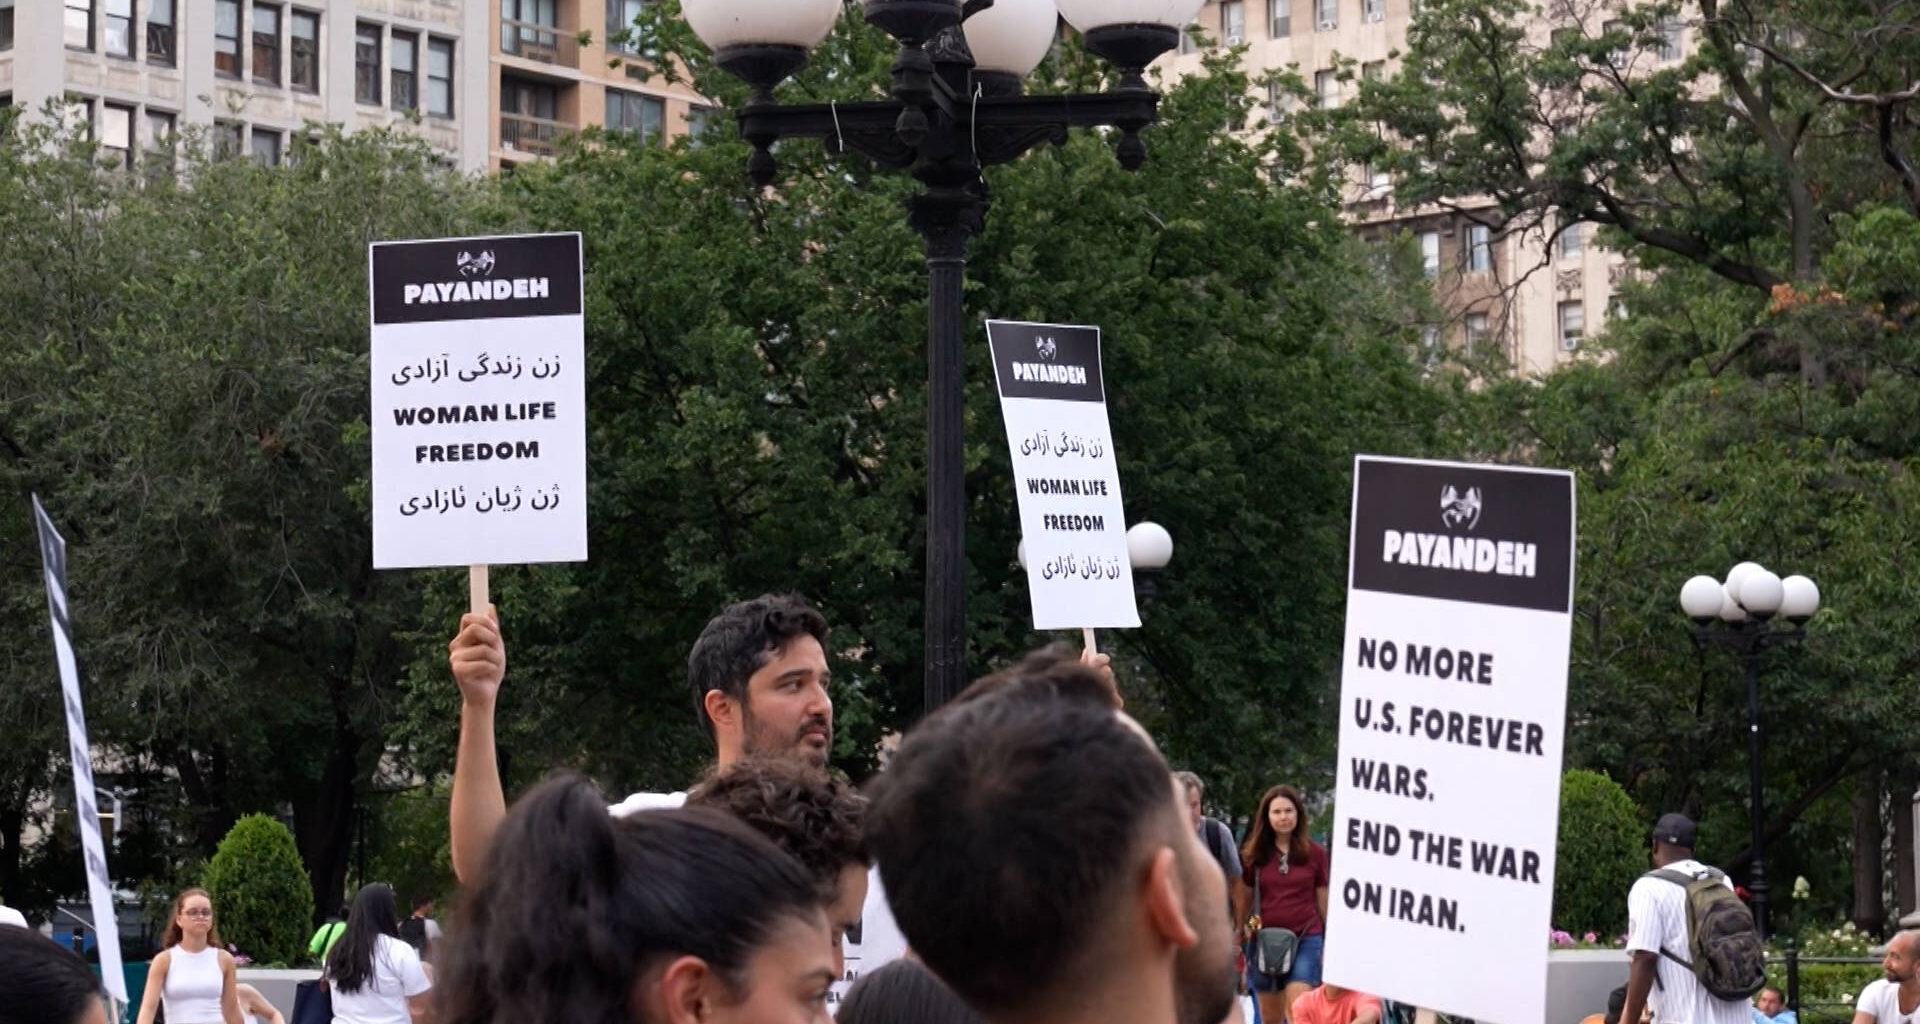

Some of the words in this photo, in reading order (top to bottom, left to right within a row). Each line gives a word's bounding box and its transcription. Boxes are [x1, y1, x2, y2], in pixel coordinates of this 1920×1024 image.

[404, 277, 548, 304] PAYANDEH
[391, 353, 449, 386] آزادی
[457, 352, 522, 383] زندگی
[531, 355, 561, 379] زن
[1012, 362, 1087, 385] PAYANDEH
[393, 404, 499, 426] WOMAN
[505, 401, 557, 421] LIFE
[415, 440, 540, 464] FREEDOM
[1020, 429, 1050, 457] آزادی
[1053, 431, 1085, 458] زندگی
[1088, 438, 1104, 460] زن
[399, 485, 466, 517] ئازادی
[475, 485, 522, 514] ژیان
[531, 483, 560, 511] ژن
[1026, 477, 1081, 496] WOMAN
[1083, 480, 1108, 497] LIFE
[1044, 513, 1105, 532] FREEDOM
[1383, 530, 1537, 578] PAYANDEH
[1357, 637, 1398, 671] NO
[1405, 643, 1494, 686] MORE
[1354, 697, 1402, 734] U.S.
[1409, 705, 1544, 757] FOREVER
[1351, 757, 1434, 802] WARS.
[1346, 817, 1401, 857] END
[1408, 829, 1463, 870] THE
[1470, 840, 1541, 884] WAR
[1342, 877, 1382, 915] ON
[1388, 887, 1465, 934] IRAN.
